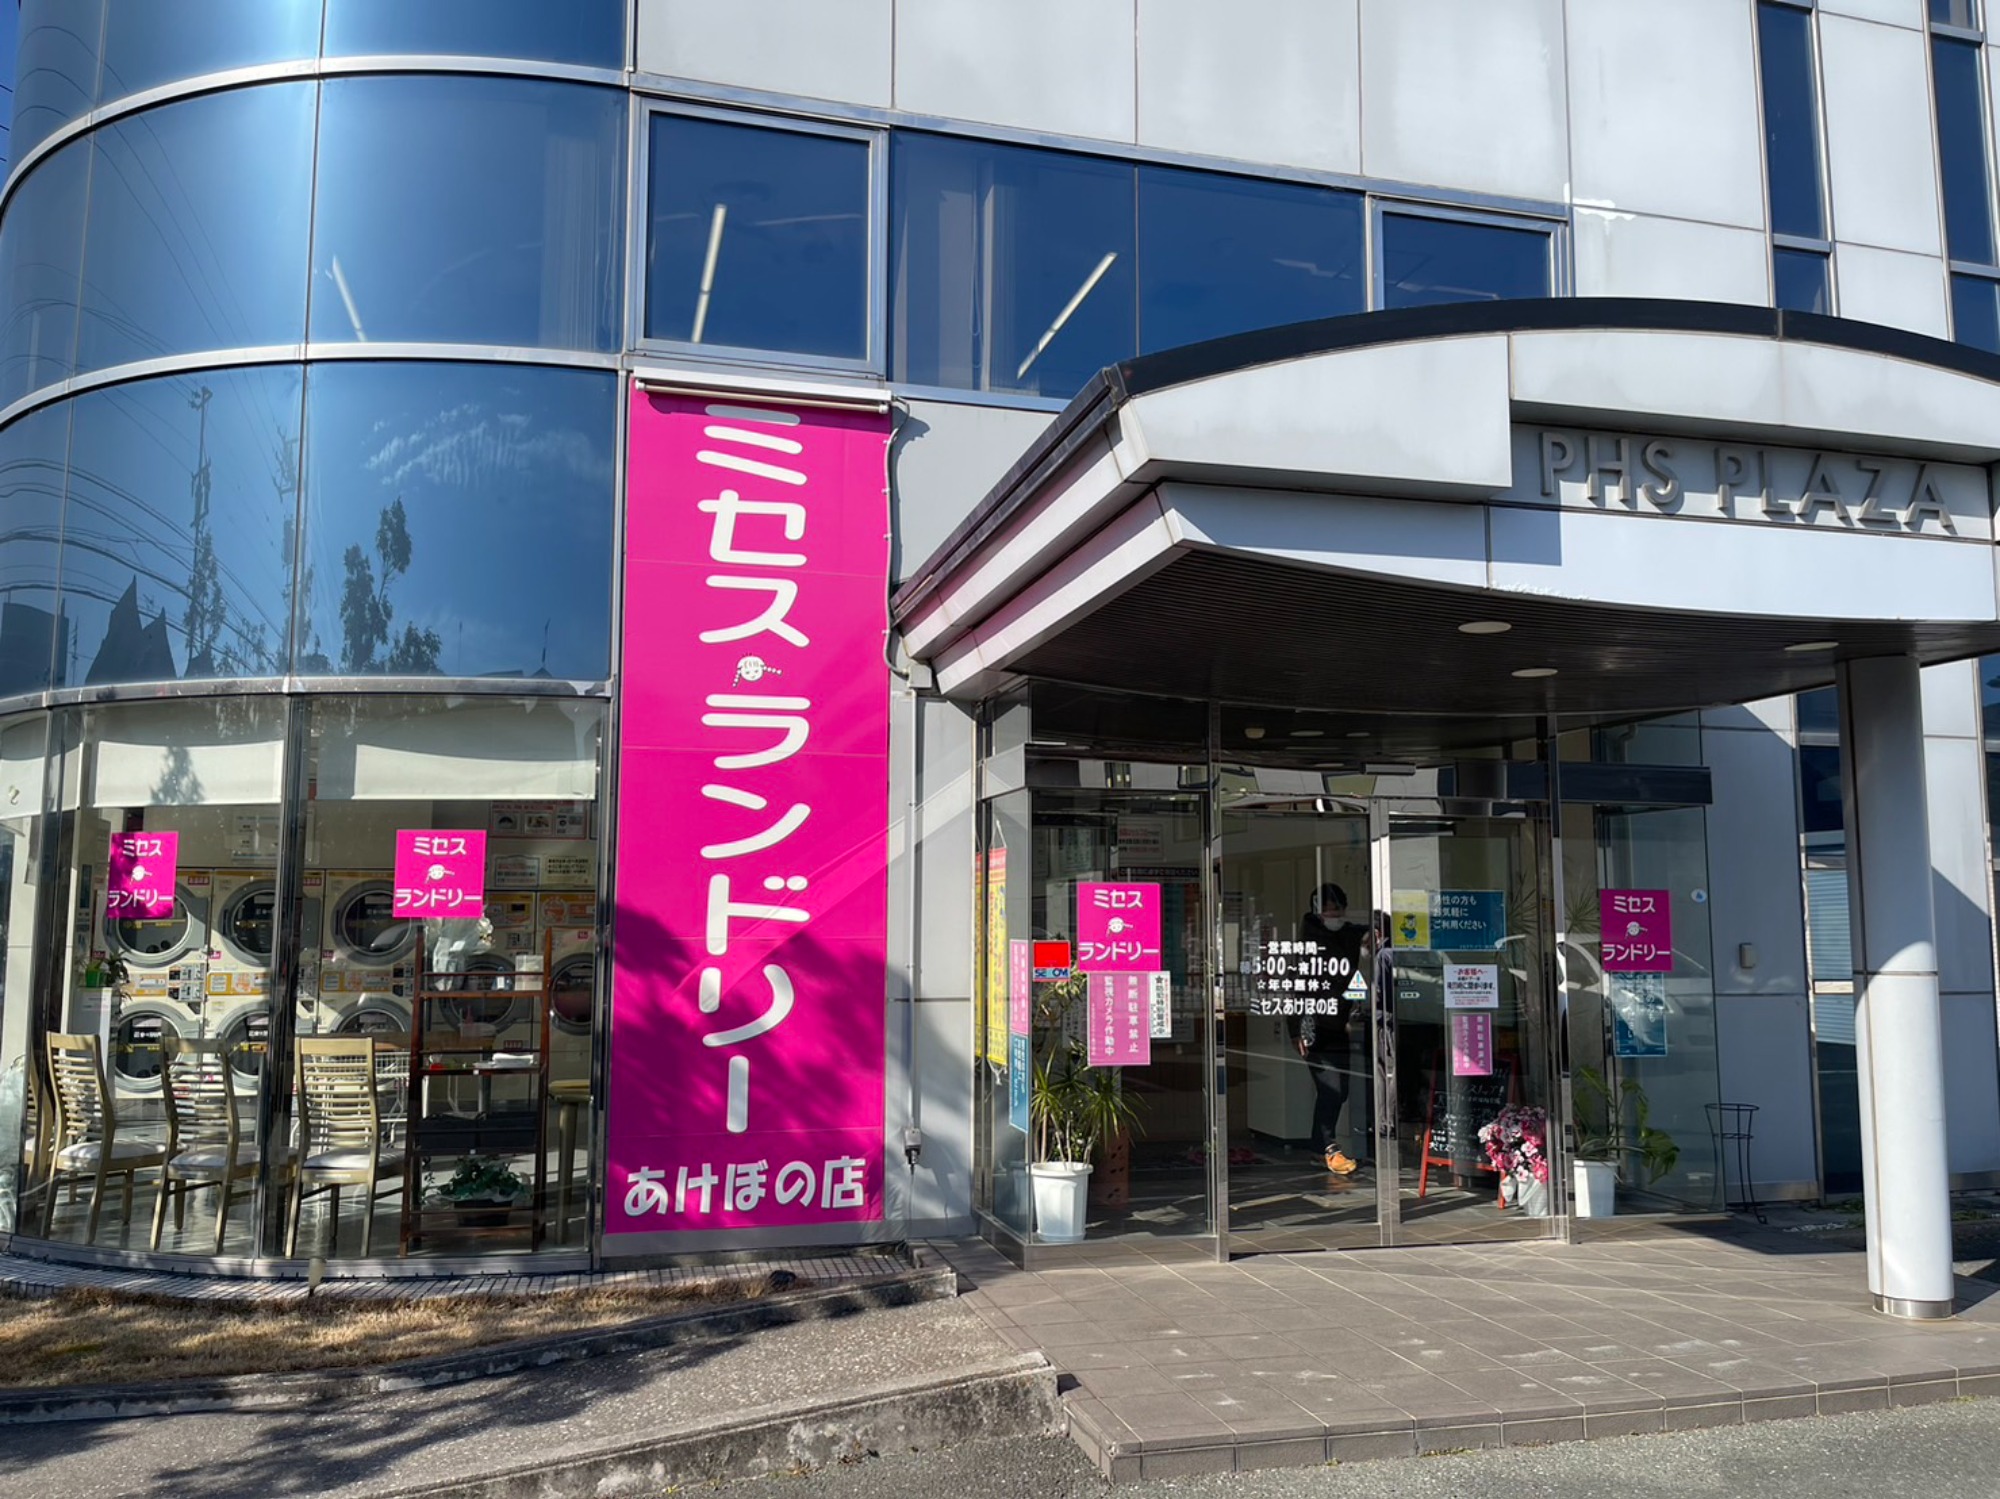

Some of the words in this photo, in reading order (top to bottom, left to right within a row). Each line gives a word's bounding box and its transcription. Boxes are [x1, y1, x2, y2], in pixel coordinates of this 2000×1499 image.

[1540, 432, 1680, 505] PHS
[1716, 448, 1954, 529] PLAZA
[696, 404, 810, 648] ミセス
[122, 839, 162, 857] ミセス
[413, 837, 467, 856] ミセス
[108, 888, 173, 908] ランドリー
[395, 888, 482, 908] ランドリー
[1093, 889, 1143, 909] ミセス
[1613, 895, 1656, 913] ミセス
[698, 692, 812, 1134] ランドリー
[1079, 941, 1160, 961] ランドリー
[1602, 943, 1671, 961] ランドリー
[623, 1155, 866, 1218] あけぼの店
